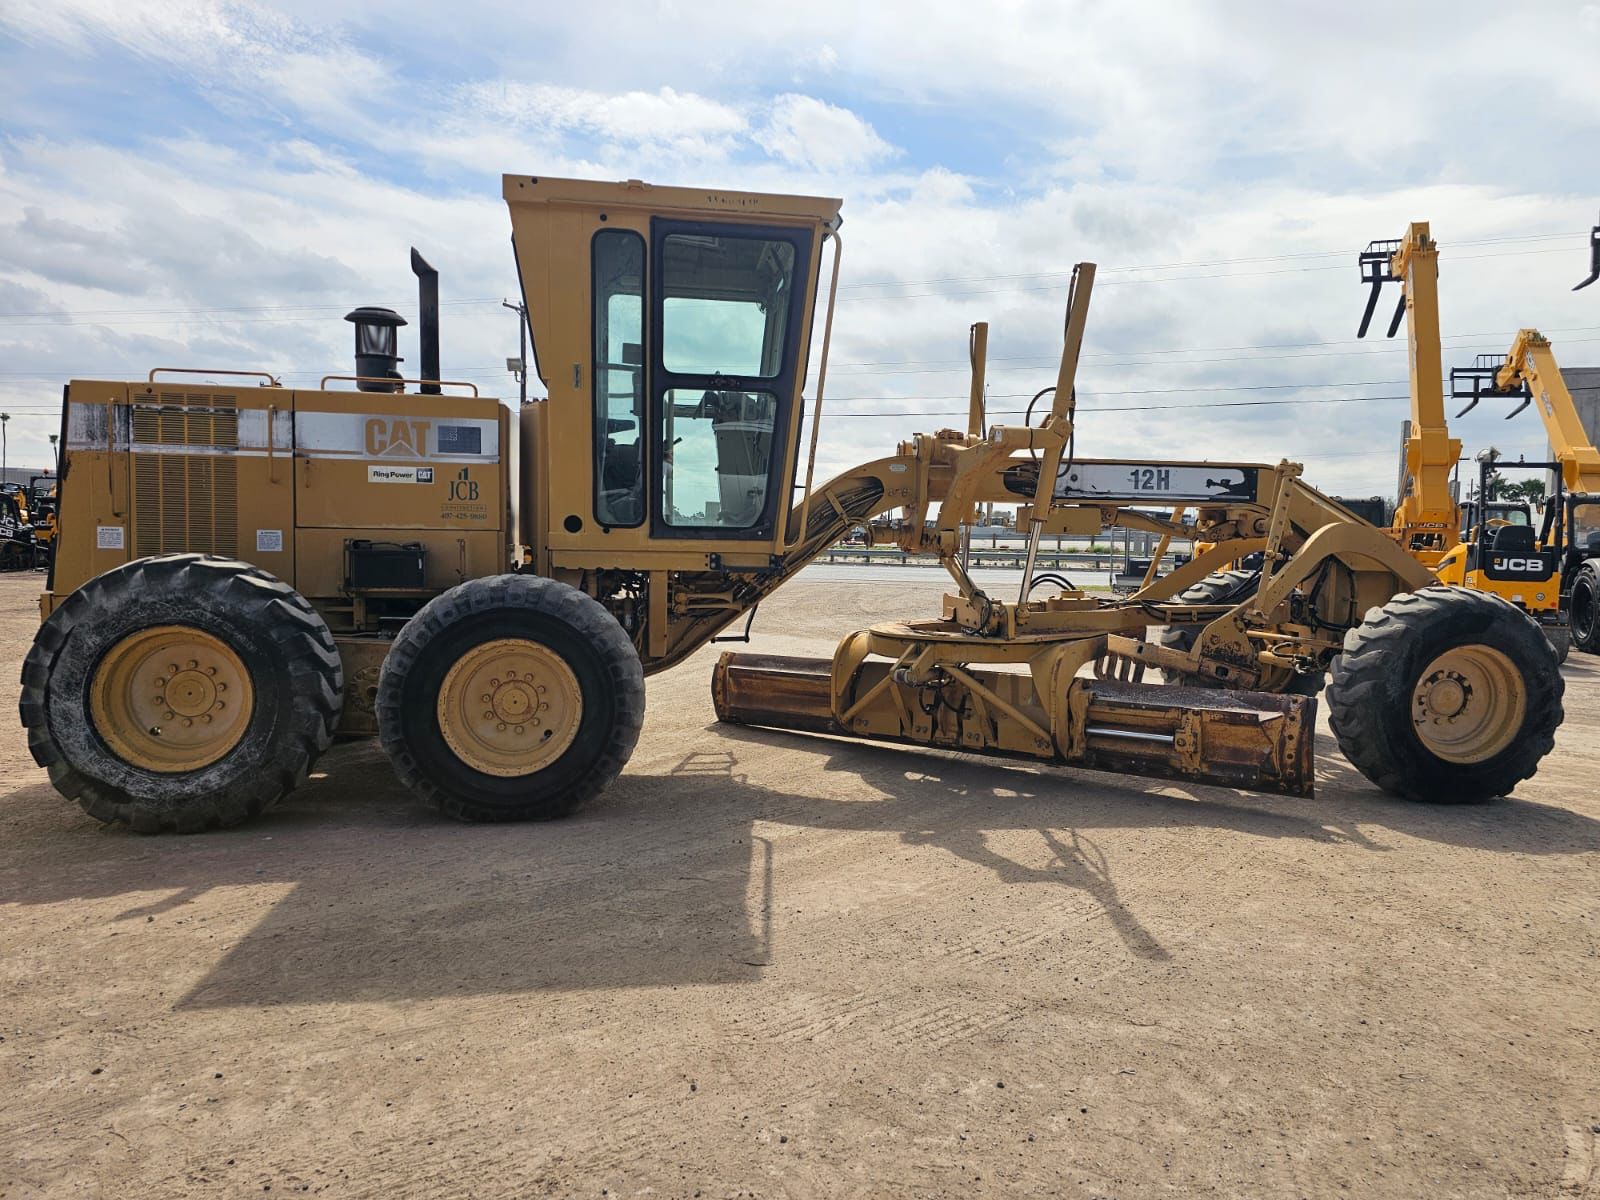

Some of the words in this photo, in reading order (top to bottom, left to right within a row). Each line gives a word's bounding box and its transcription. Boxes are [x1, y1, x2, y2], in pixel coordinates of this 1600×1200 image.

[365, 419, 431, 457] CAT
[390, 471, 413, 479] Power
[417, 470, 432, 480] CAT
[1130, 469, 1170, 490] 12H
[448, 481, 479, 501] JCB
[1494, 558, 1543, 571] JCB
